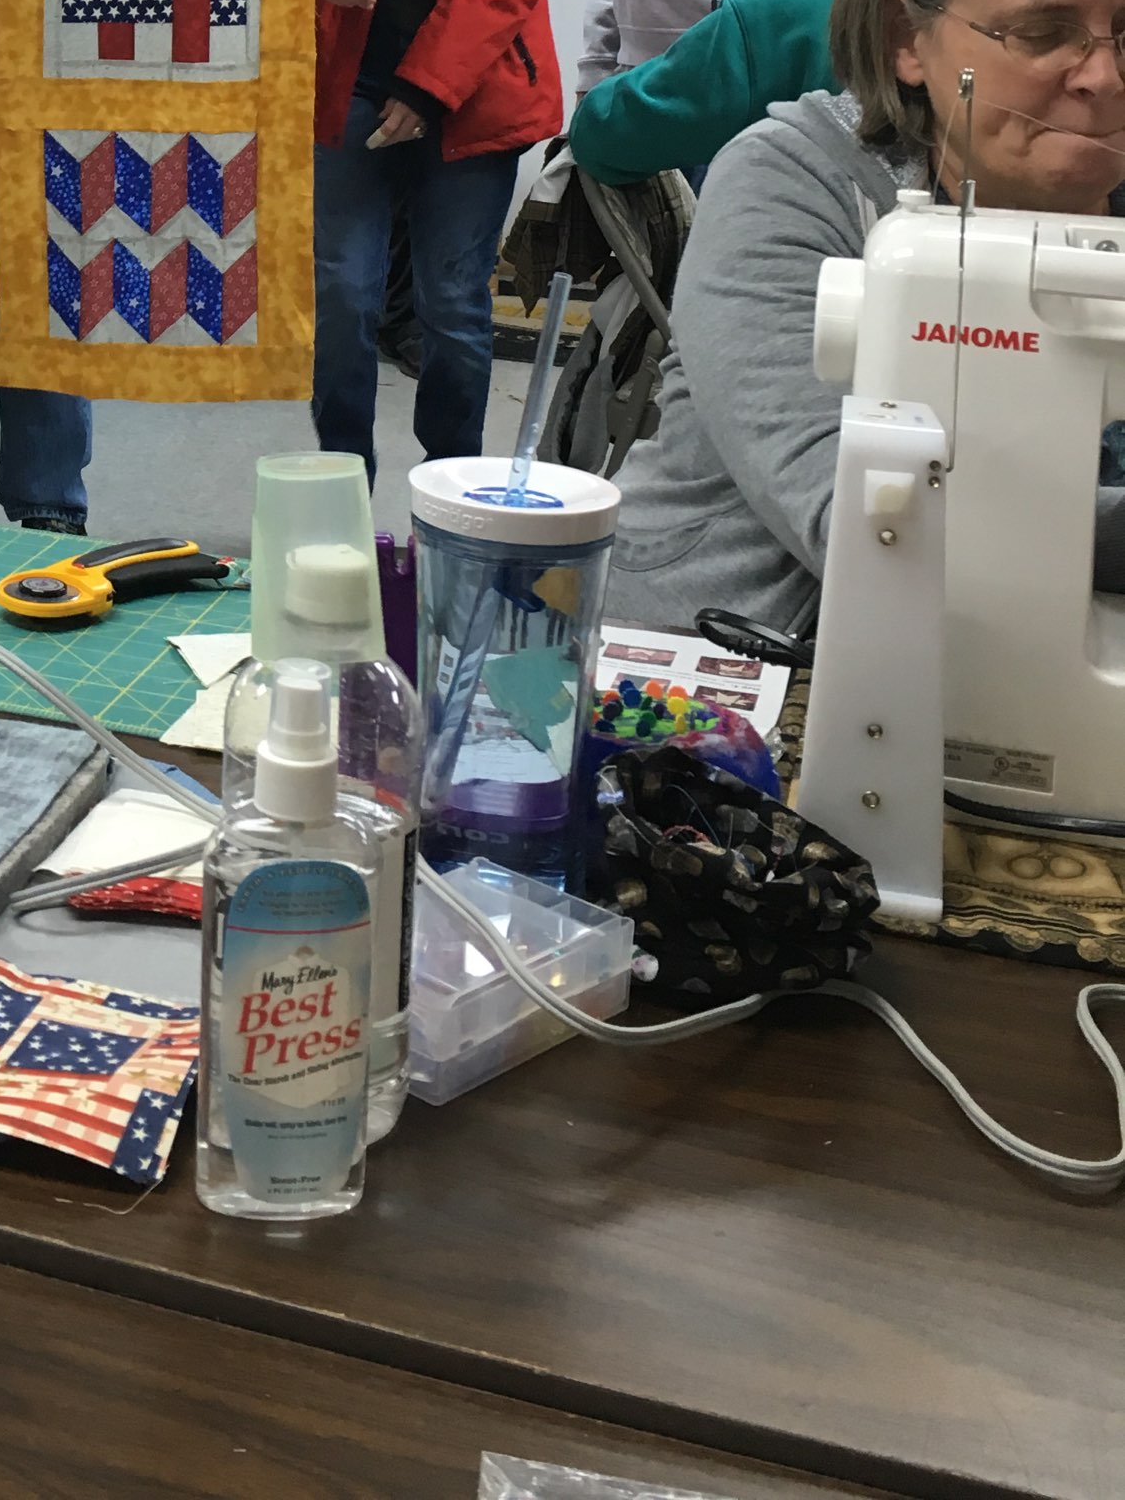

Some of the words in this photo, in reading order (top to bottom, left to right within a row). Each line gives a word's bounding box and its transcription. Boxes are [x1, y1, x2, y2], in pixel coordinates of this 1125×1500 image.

[911, 321, 1040, 353] JANOME
[261, 971, 295, 995] Mary
[237, 981, 338, 1034] Best
[241, 1017, 363, 1075] Press
